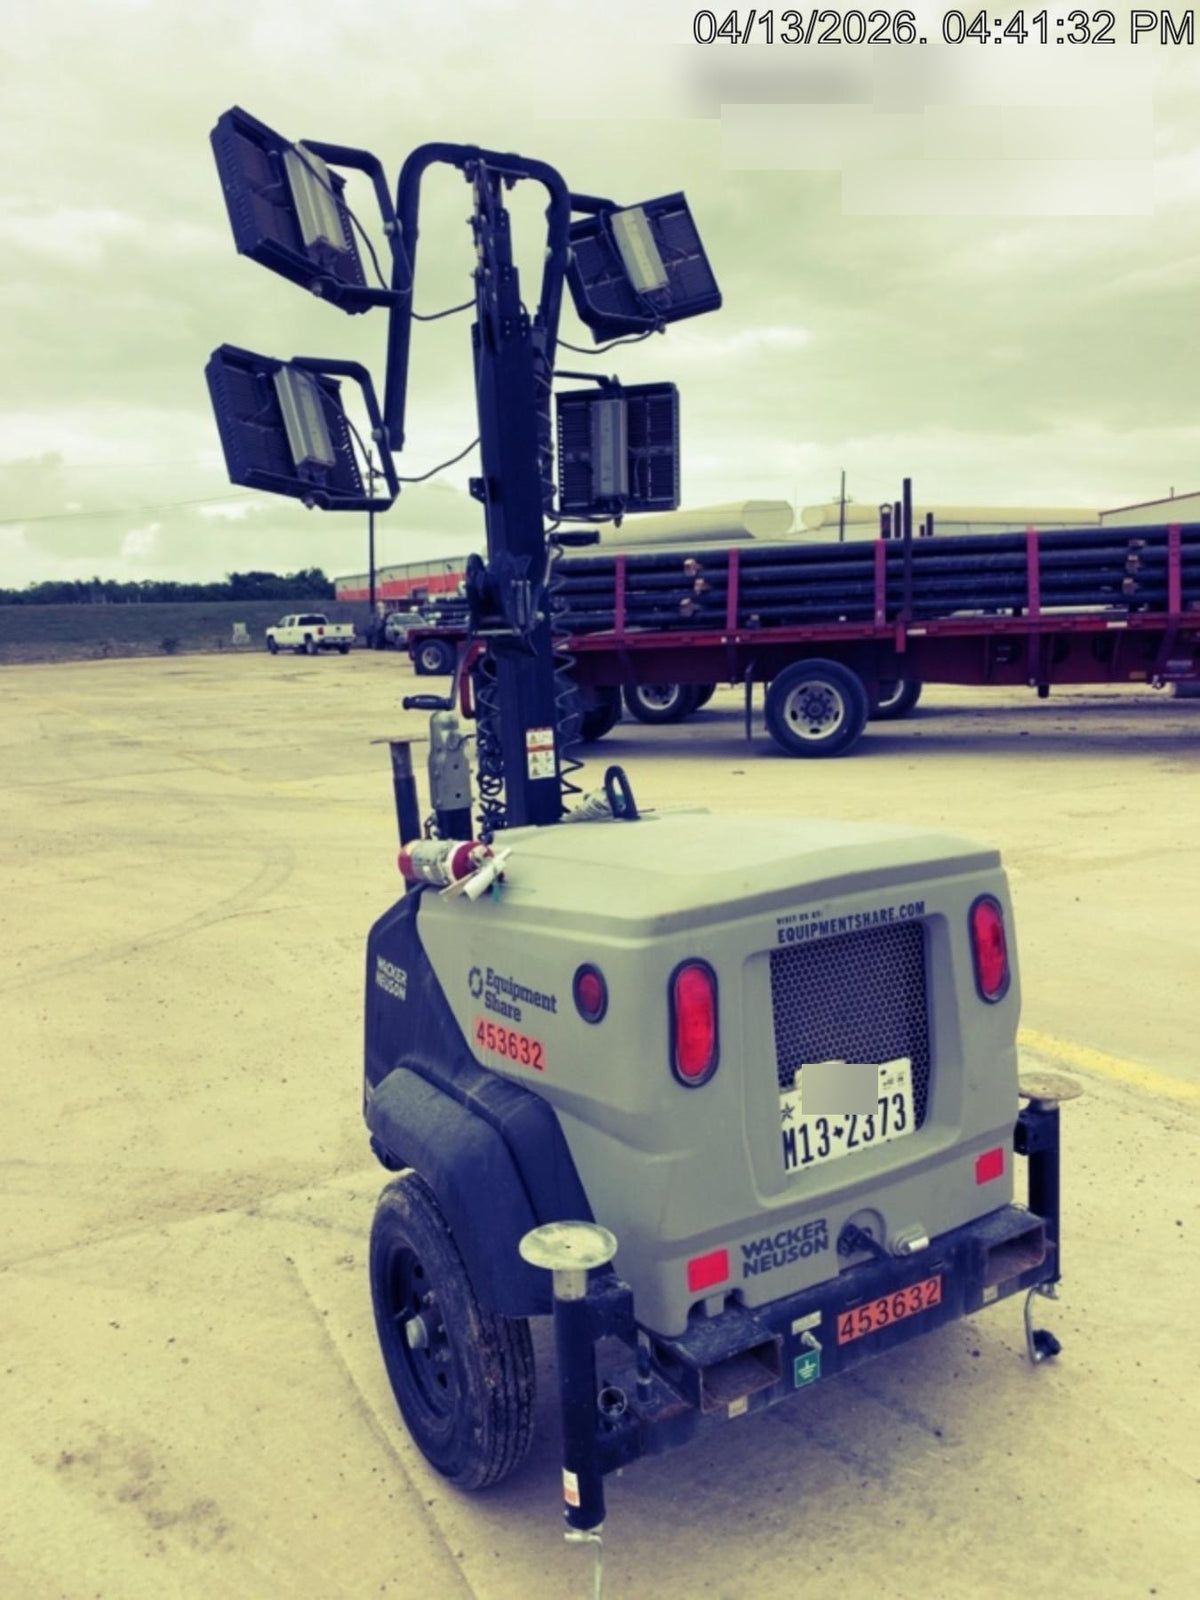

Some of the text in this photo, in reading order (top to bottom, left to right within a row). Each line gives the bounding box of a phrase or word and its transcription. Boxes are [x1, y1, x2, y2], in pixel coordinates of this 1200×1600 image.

[778, 901, 925, 943] EQUIPMENTSHARE.COM
[485, 990, 521, 1022] Share
[486, 968, 557, 1014] Equipment
[476, 1021, 543, 1070] 453632
[741, 1218, 827, 1260] WACKER
[743, 1235, 828, 1278] NEUSON
[842, 1279, 940, 1339] 453632
